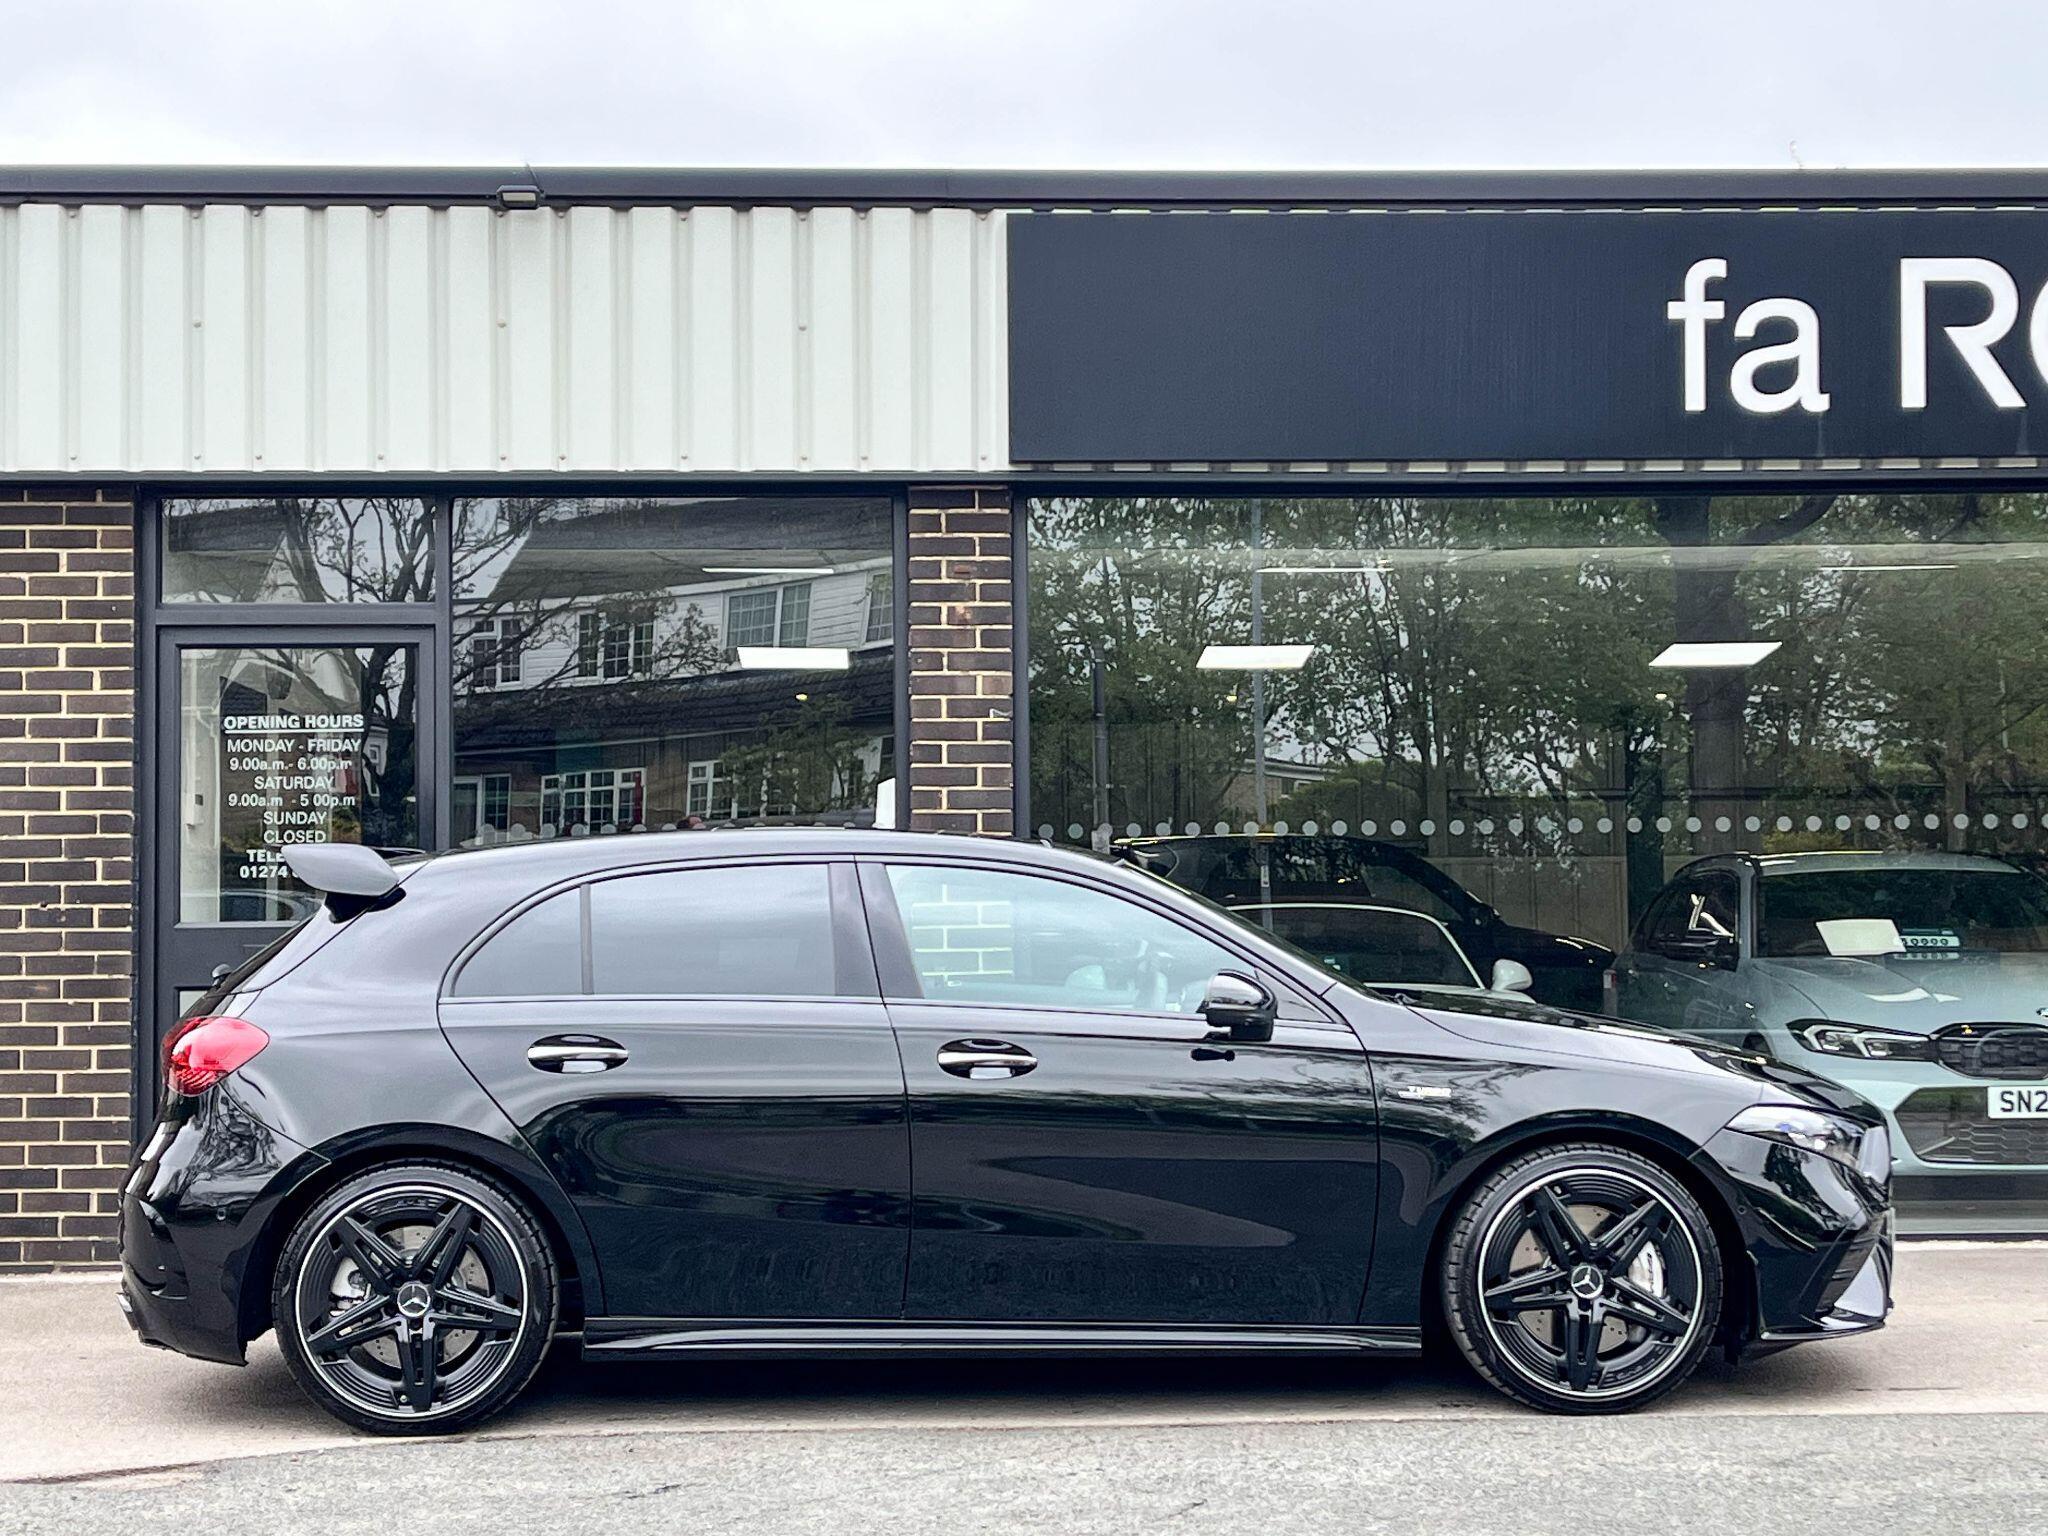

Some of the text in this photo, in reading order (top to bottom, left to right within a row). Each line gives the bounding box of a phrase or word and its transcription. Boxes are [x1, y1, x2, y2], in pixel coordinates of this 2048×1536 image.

[1666, 257, 2048, 413] fa R
[223, 714, 364, 729] OPENING HOURS
[227, 739, 295, 752] MONDAY
[307, 738, 361, 752] FRIDAY
[254, 776, 334, 790] SATURDAY
[263, 811, 327, 825] SUNDAY
[263, 829, 327, 844] CLOSED
[240, 865, 288, 878] 01274
[2000, 1090, 2048, 1112] SN2
